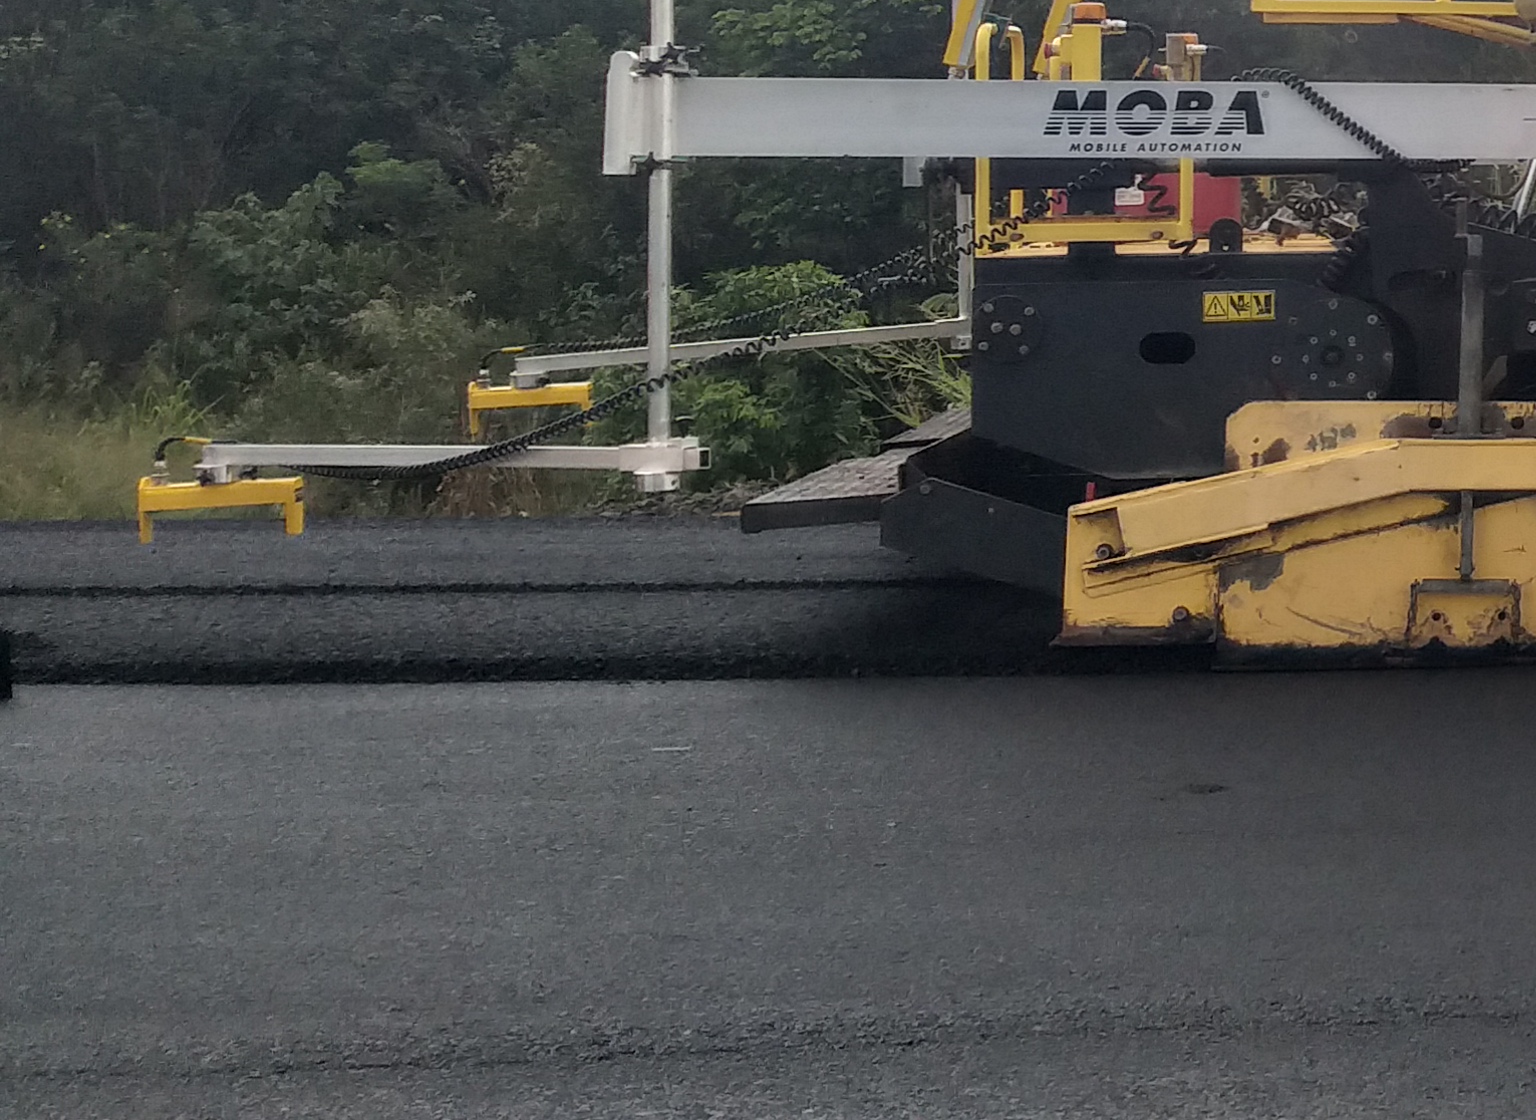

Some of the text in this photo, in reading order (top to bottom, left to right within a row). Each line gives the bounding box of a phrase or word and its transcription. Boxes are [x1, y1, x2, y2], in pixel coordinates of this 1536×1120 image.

[1043, 89, 1265, 136] MOBA
[1068, 142, 1242, 153] MOBILE AUTOMATION
